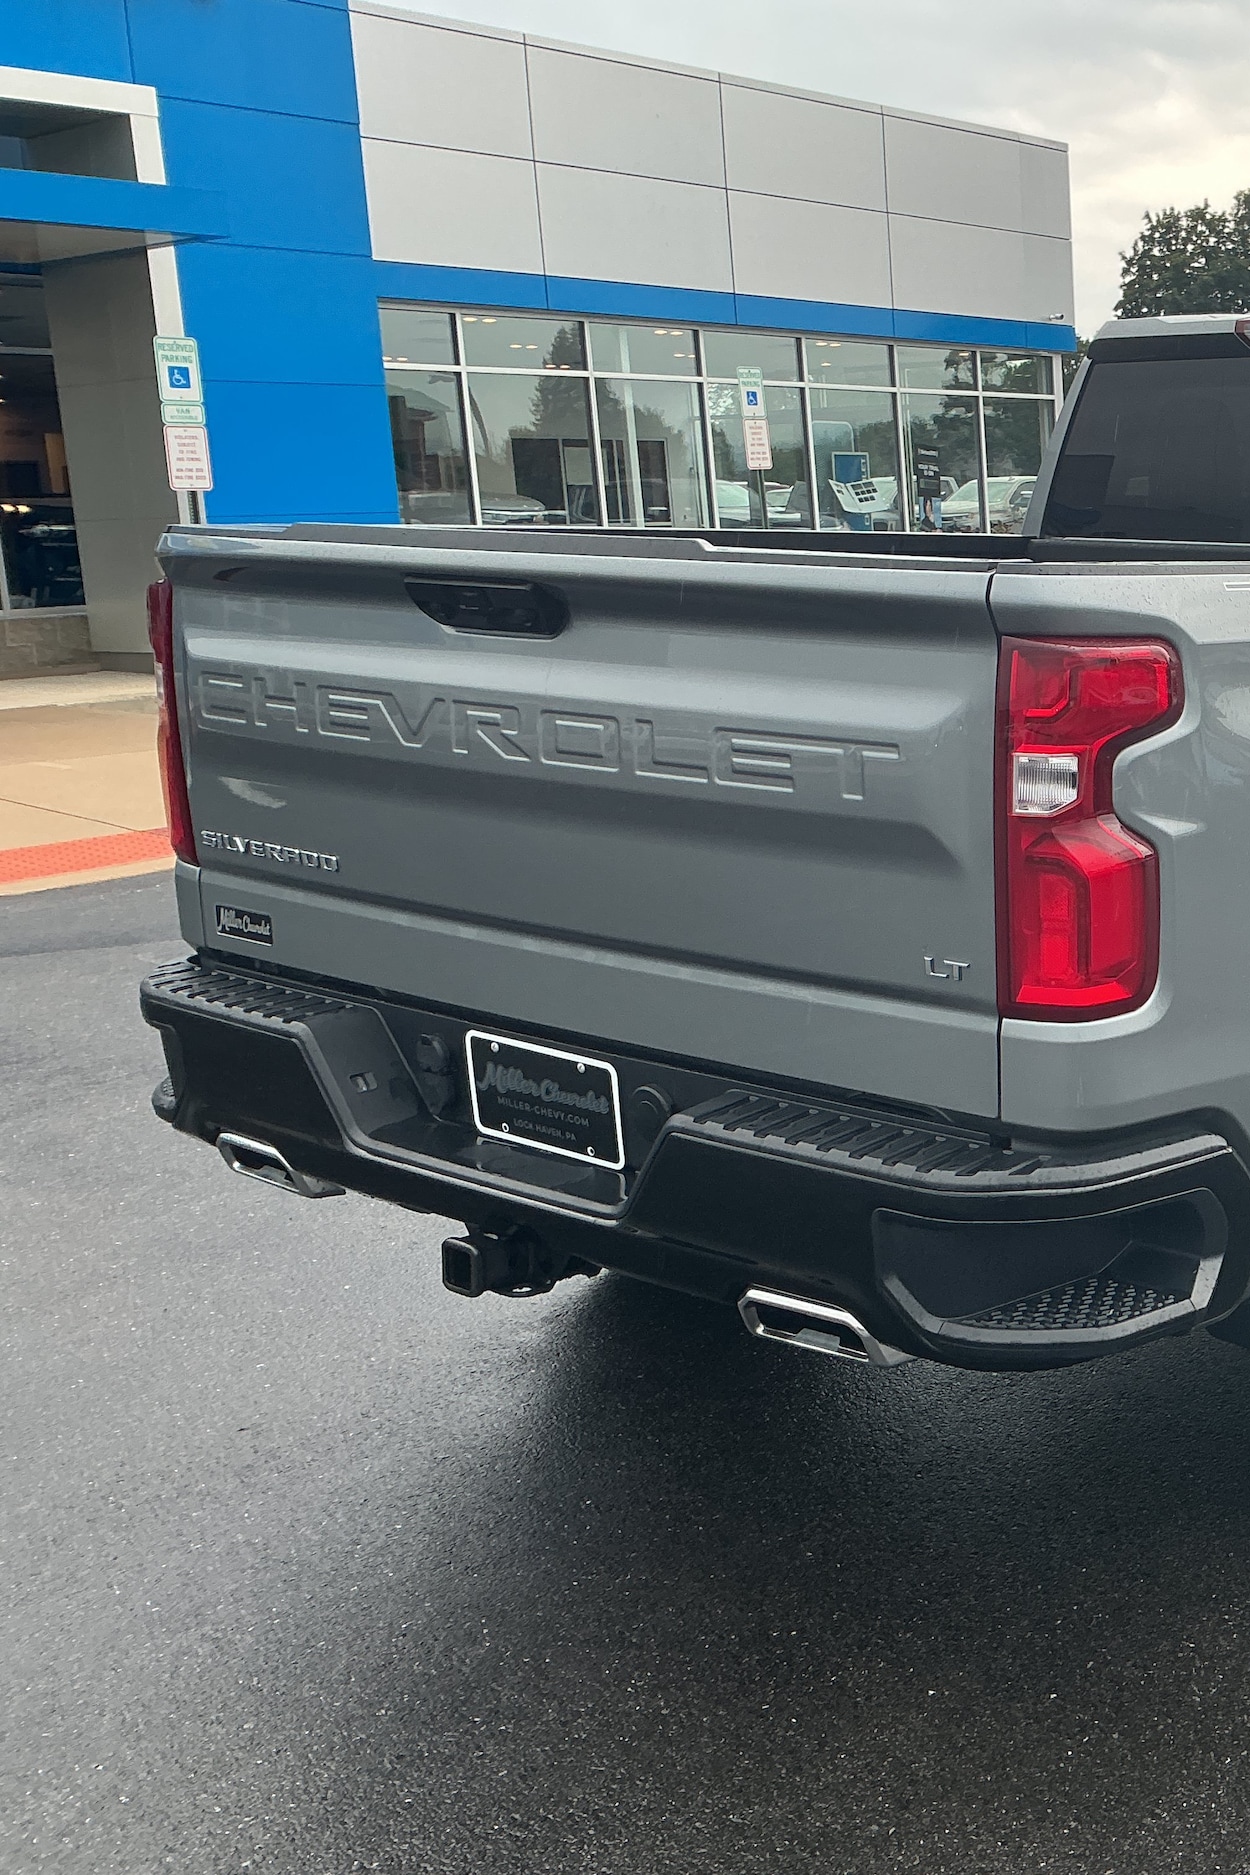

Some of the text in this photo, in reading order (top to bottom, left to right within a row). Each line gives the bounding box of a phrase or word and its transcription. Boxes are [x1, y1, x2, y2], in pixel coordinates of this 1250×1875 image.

[157, 342, 194, 353] RESERVED
[160, 354, 193, 364] PARKING
[176, 407, 191, 415] VAN
[198, 673, 900, 801] CHEVROLET
[200, 830, 340, 872] SILVERADO
[217, 907, 242, 931] Miller
[923, 956, 970, 981] LT
[476, 1060, 610, 1115] Miller Chevrolet
[496, 1095, 590, 1128] MILLER-CHEVY.COM
[513, 1117, 534, 1131] LOCK
[564, 1130, 577, 1142] PA
